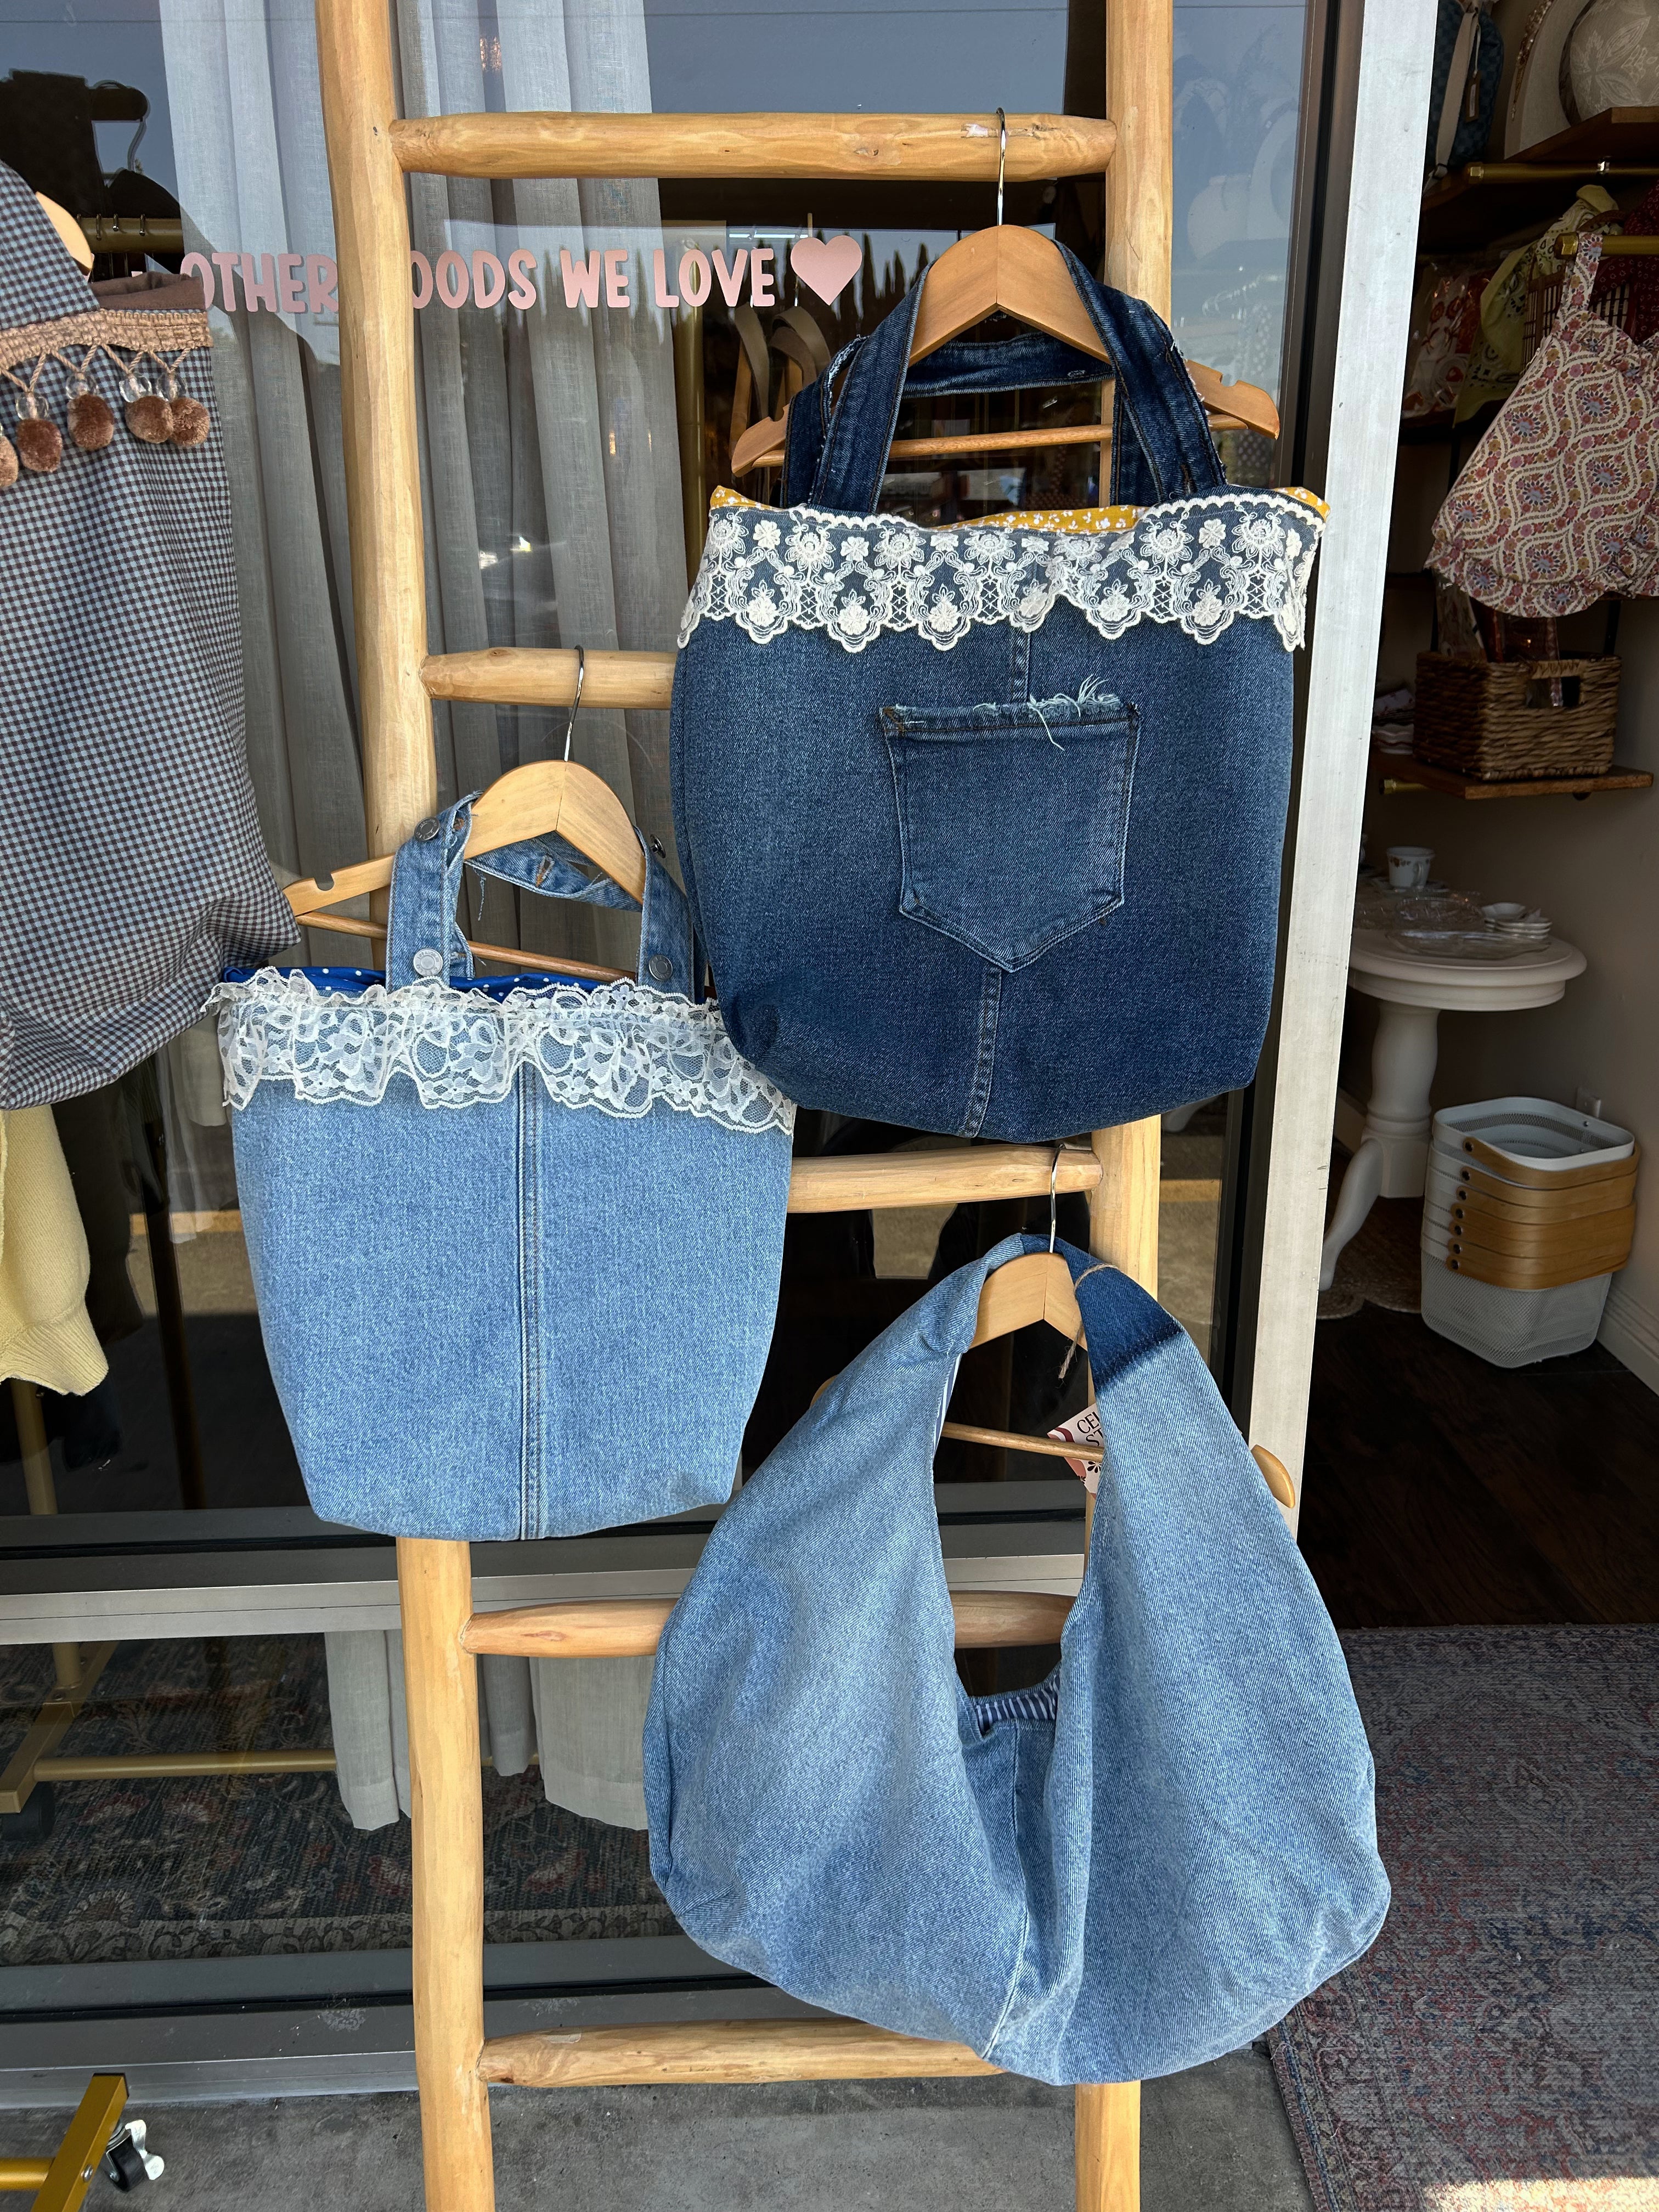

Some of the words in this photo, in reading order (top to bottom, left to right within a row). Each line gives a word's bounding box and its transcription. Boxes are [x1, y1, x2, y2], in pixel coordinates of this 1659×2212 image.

[410, 250, 537, 309] OODS
[560, 249, 630, 308] WE
[653, 249, 775, 307] LOVE
